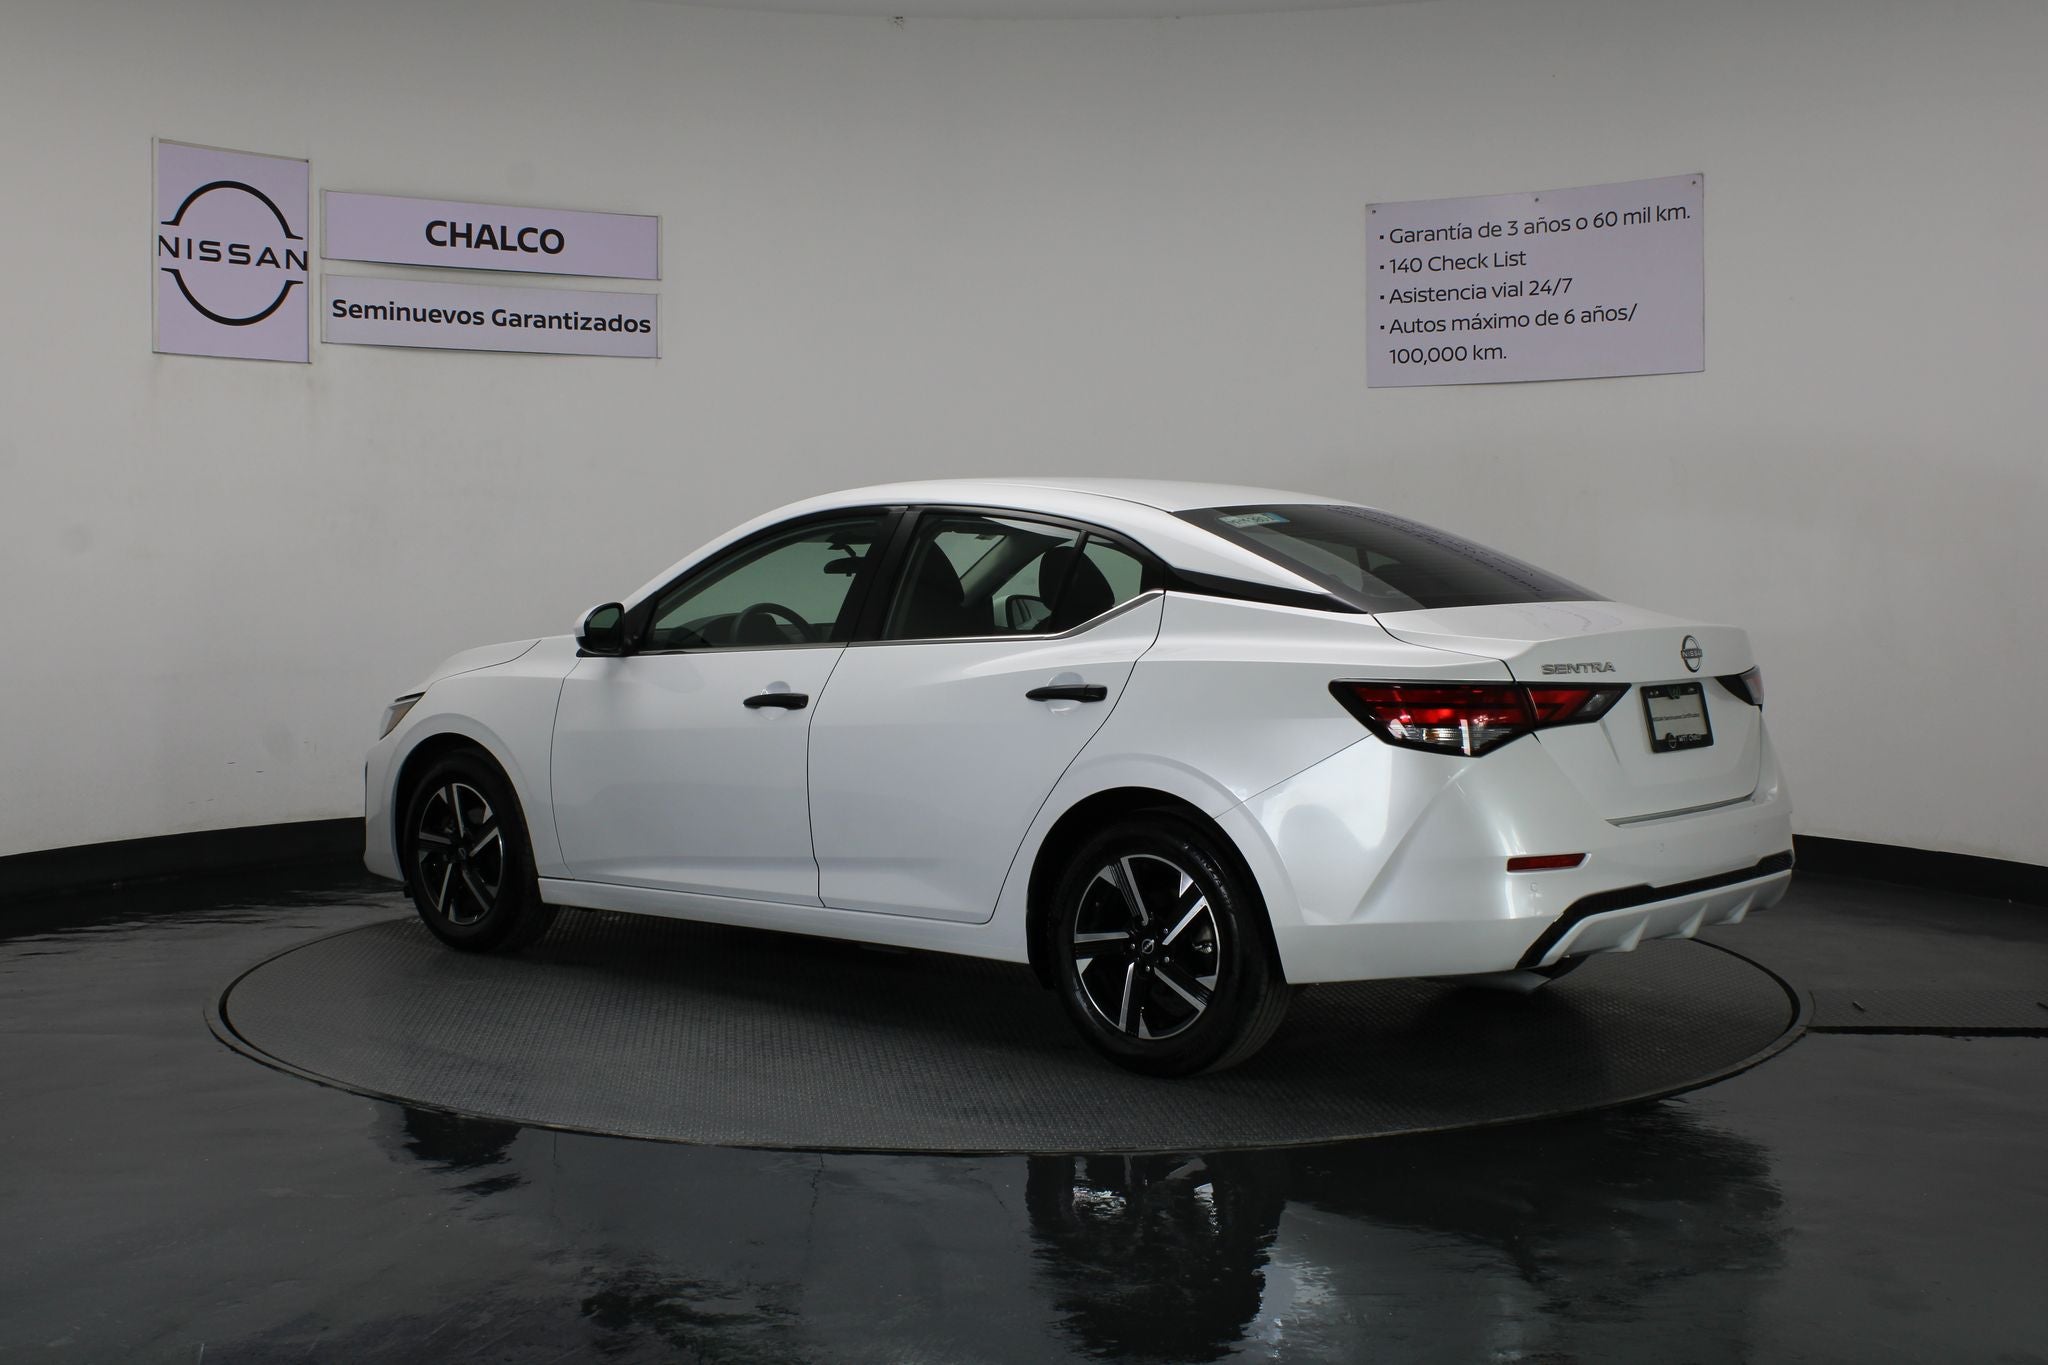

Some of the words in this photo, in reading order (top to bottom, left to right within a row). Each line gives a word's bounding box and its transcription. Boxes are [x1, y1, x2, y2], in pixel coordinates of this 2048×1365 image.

[425, 220, 566, 255] CHALCO
[1389, 222, 1473, 244] Garantía
[1477, 221, 1502, 239] de
[1507, 220, 1519, 237] 3
[1523, 216, 1571, 235] años
[1575, 217, 1588, 231] o
[1592, 211, 1618, 229] 60
[1623, 206, 1651, 226] mil
[1656, 205, 1691, 222] km.
[158, 234, 308, 272] NISSAN
[1389, 257, 1423, 274] 140
[1427, 252, 1489, 272] Check
[1493, 250, 1527, 268] List
[1388, 283, 1487, 305] Asistencia
[1491, 280, 1523, 299] vial
[1528, 277, 1573, 297] 24/7
[332, 298, 485, 326] Seminuevos
[491, 308, 652, 334] Garantizados
[1388, 317, 1447, 335] Autos
[1451, 312, 1530, 332] máximo
[1534, 309, 1559, 327] de
[1563, 308, 1576, 325] 6
[1580, 303, 1638, 324] años/
[1388, 345, 1468, 366] 100,000
[1473, 344, 1507, 361] km.
[1541, 661, 1616, 675] SENTRA
